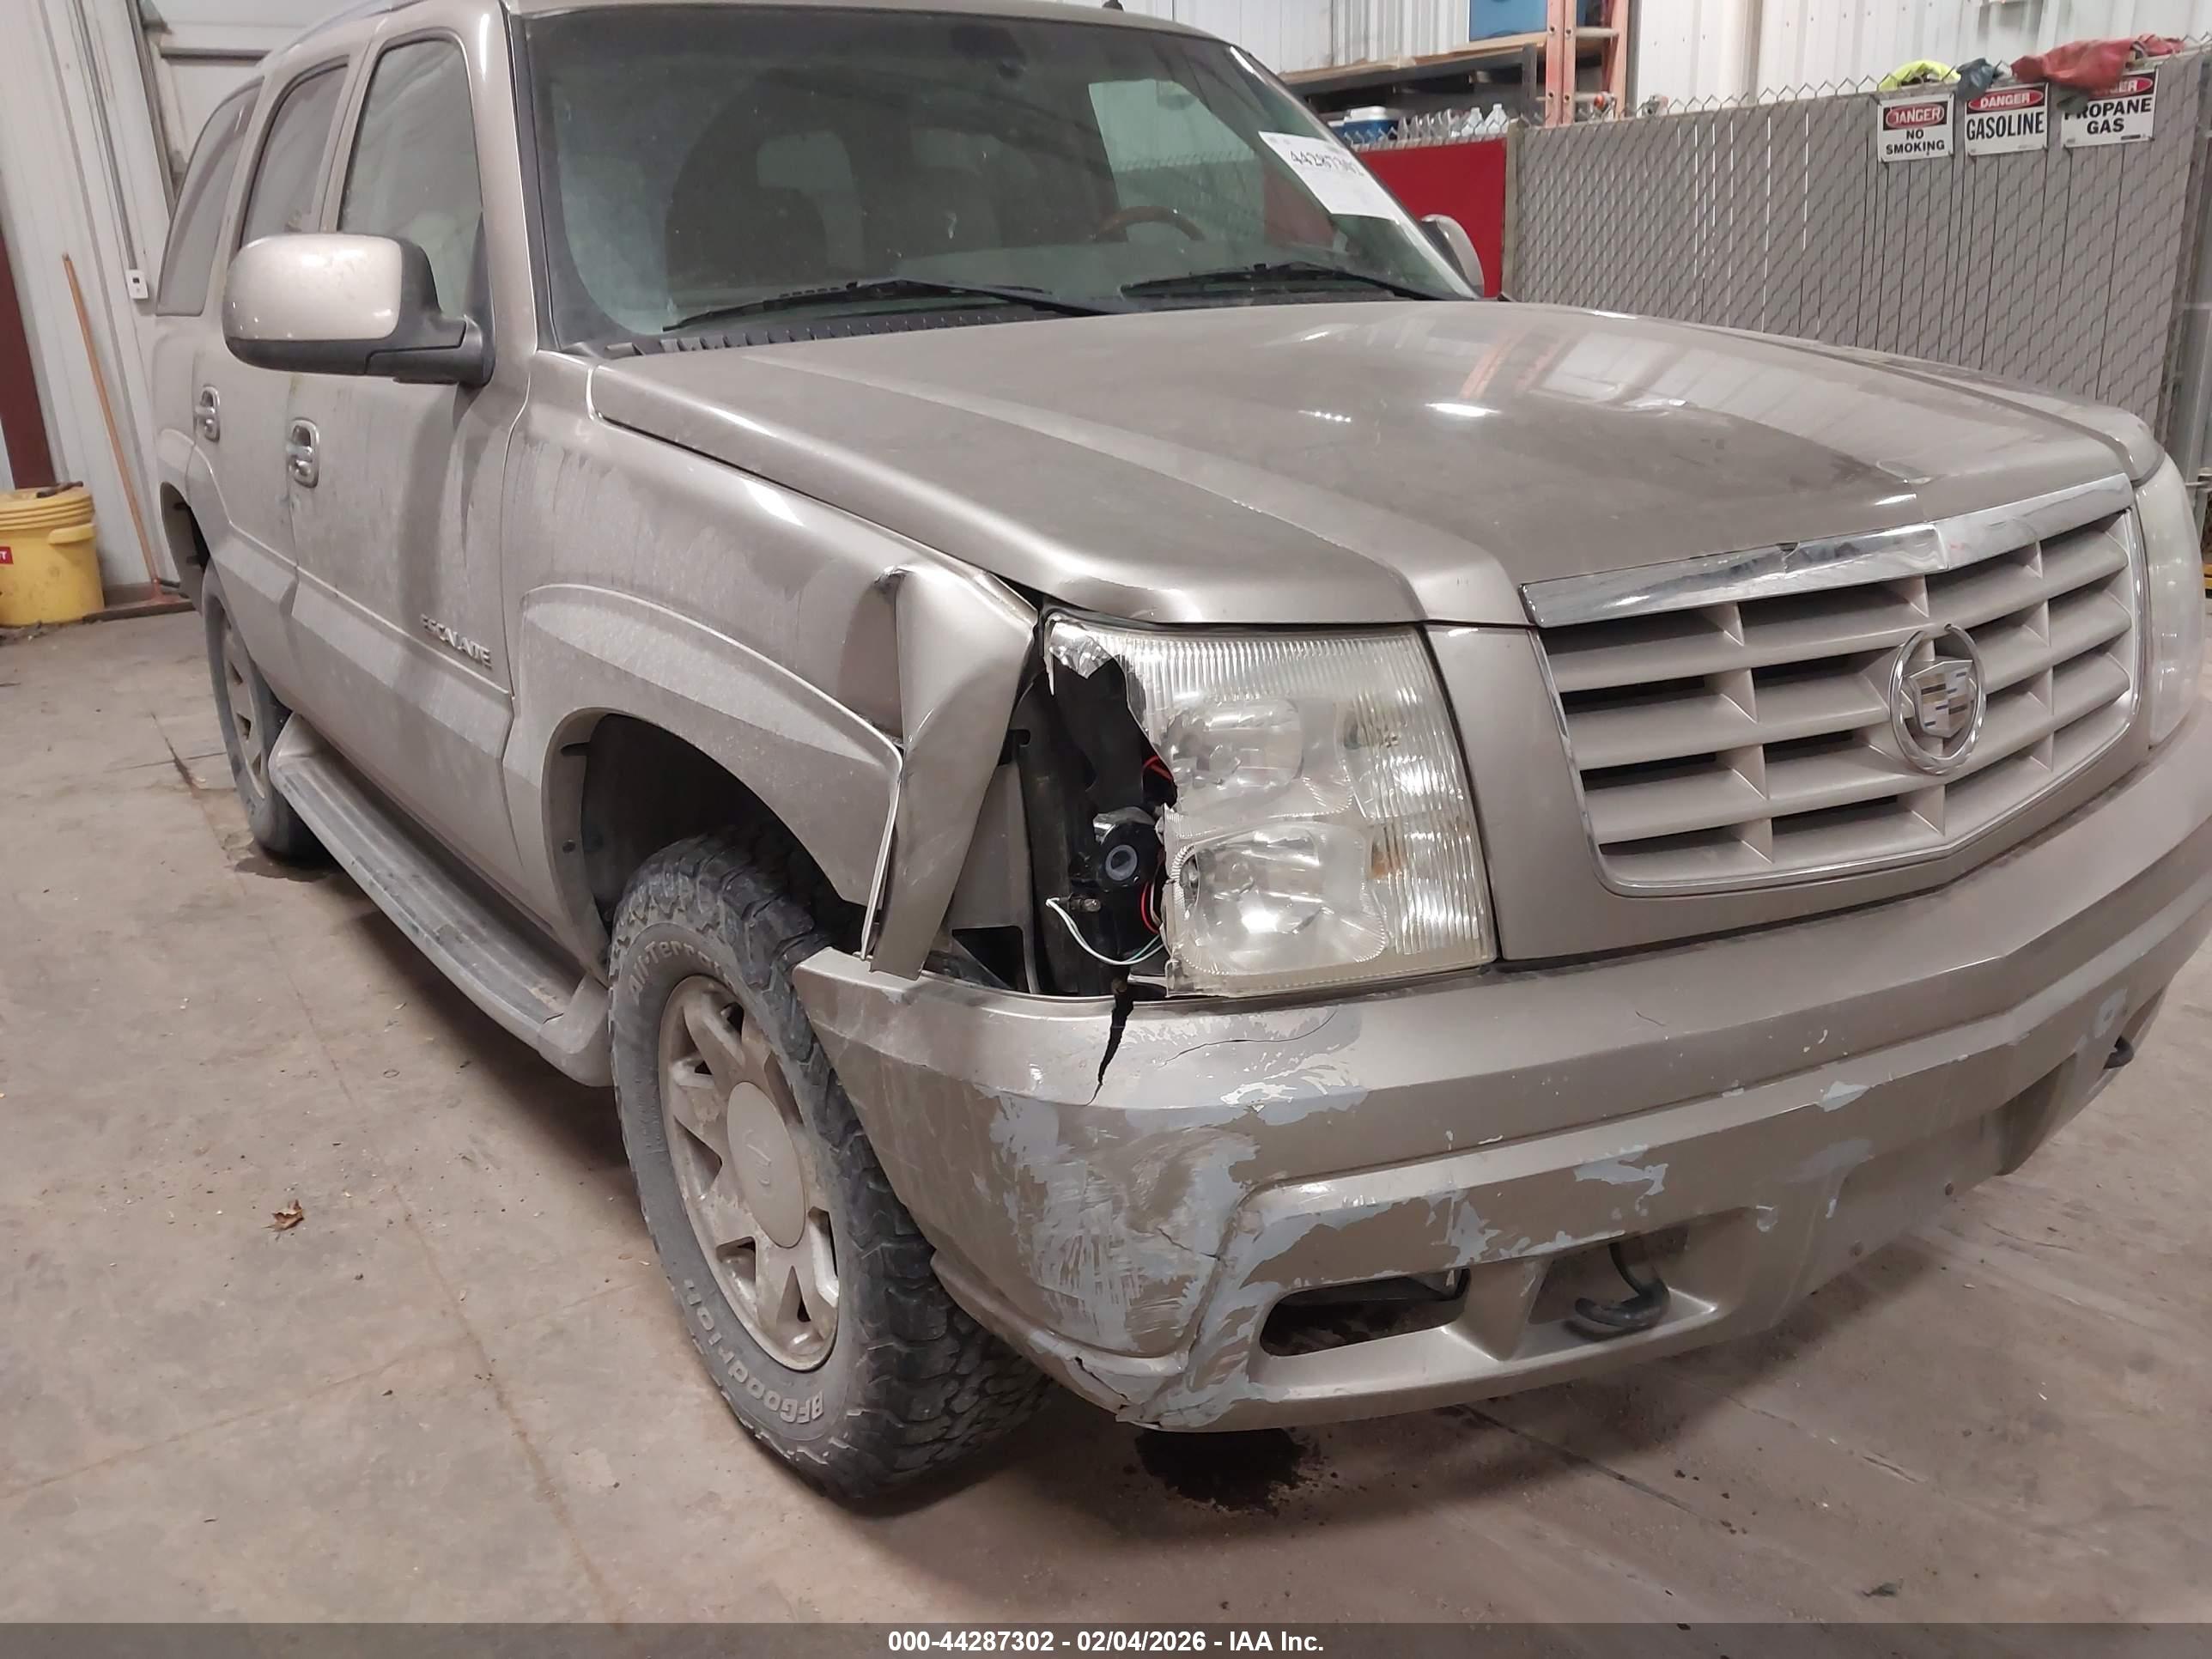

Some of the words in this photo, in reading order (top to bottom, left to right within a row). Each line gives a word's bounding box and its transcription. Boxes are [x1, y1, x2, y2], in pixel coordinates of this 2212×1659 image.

[1978, 92, 2030, 109] DANGER
[1906, 128, 1924, 140] NO
[1966, 111, 2045, 141] GASOLINE
[2087, 118, 2125, 135] GAS
[1886, 139, 1946, 155] SMOKING
